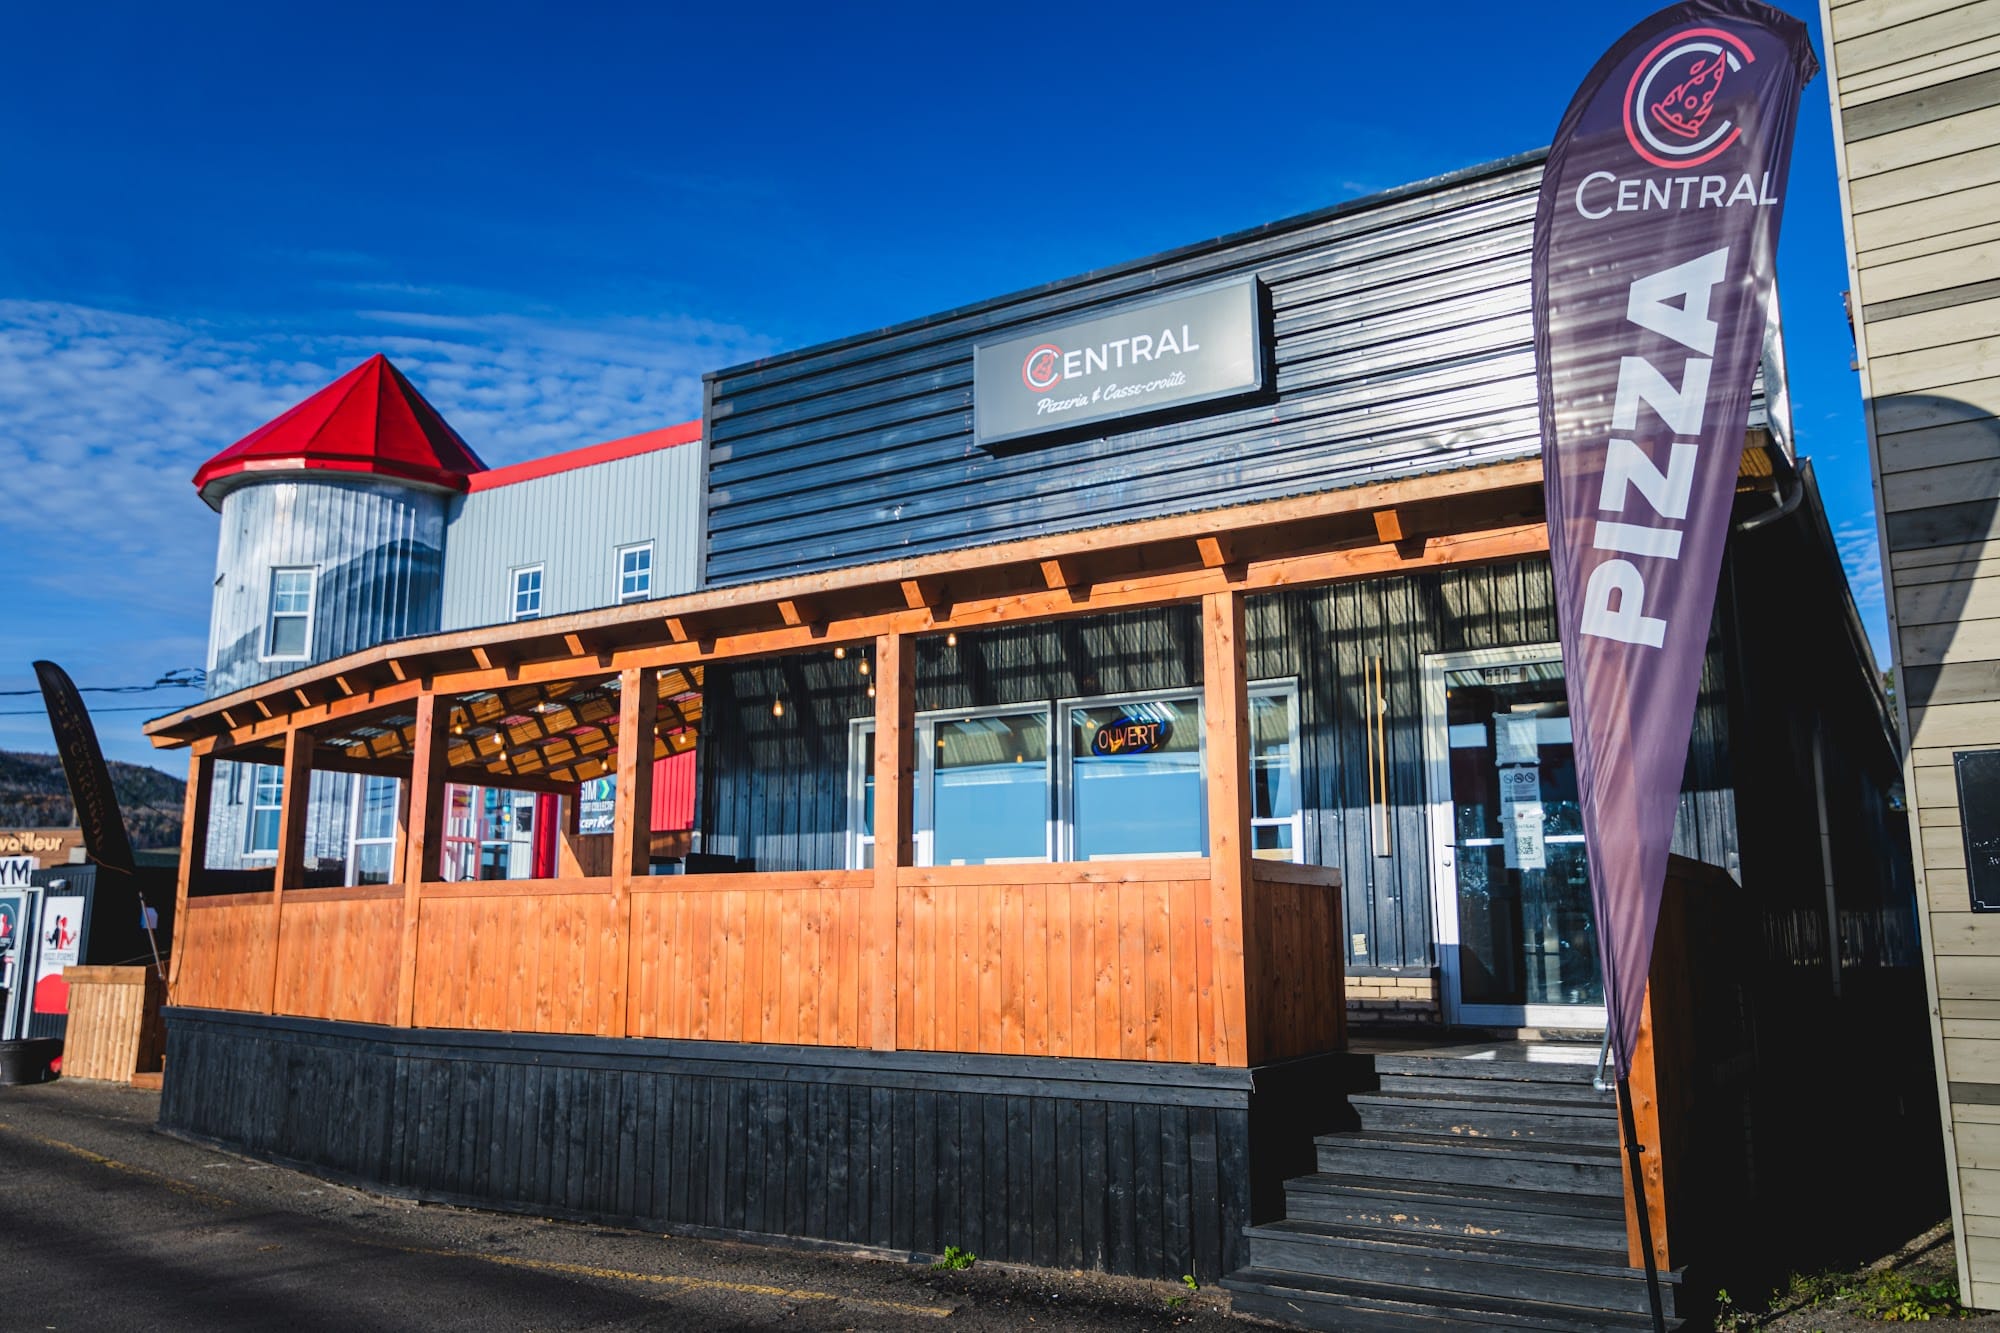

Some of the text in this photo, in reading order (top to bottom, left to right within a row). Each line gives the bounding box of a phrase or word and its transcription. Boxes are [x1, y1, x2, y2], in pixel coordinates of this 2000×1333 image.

[1575, 170, 1779, 220] CENTRAL
[1022, 324, 1200, 393] CENTRAL
[1036, 394, 1089, 416] Pizzeria
[1102, 370, 1187, 402] Casse-croûte
[1580, 246, 1730, 649] PIZZA
[1098, 723, 1158, 749] OUVERT
